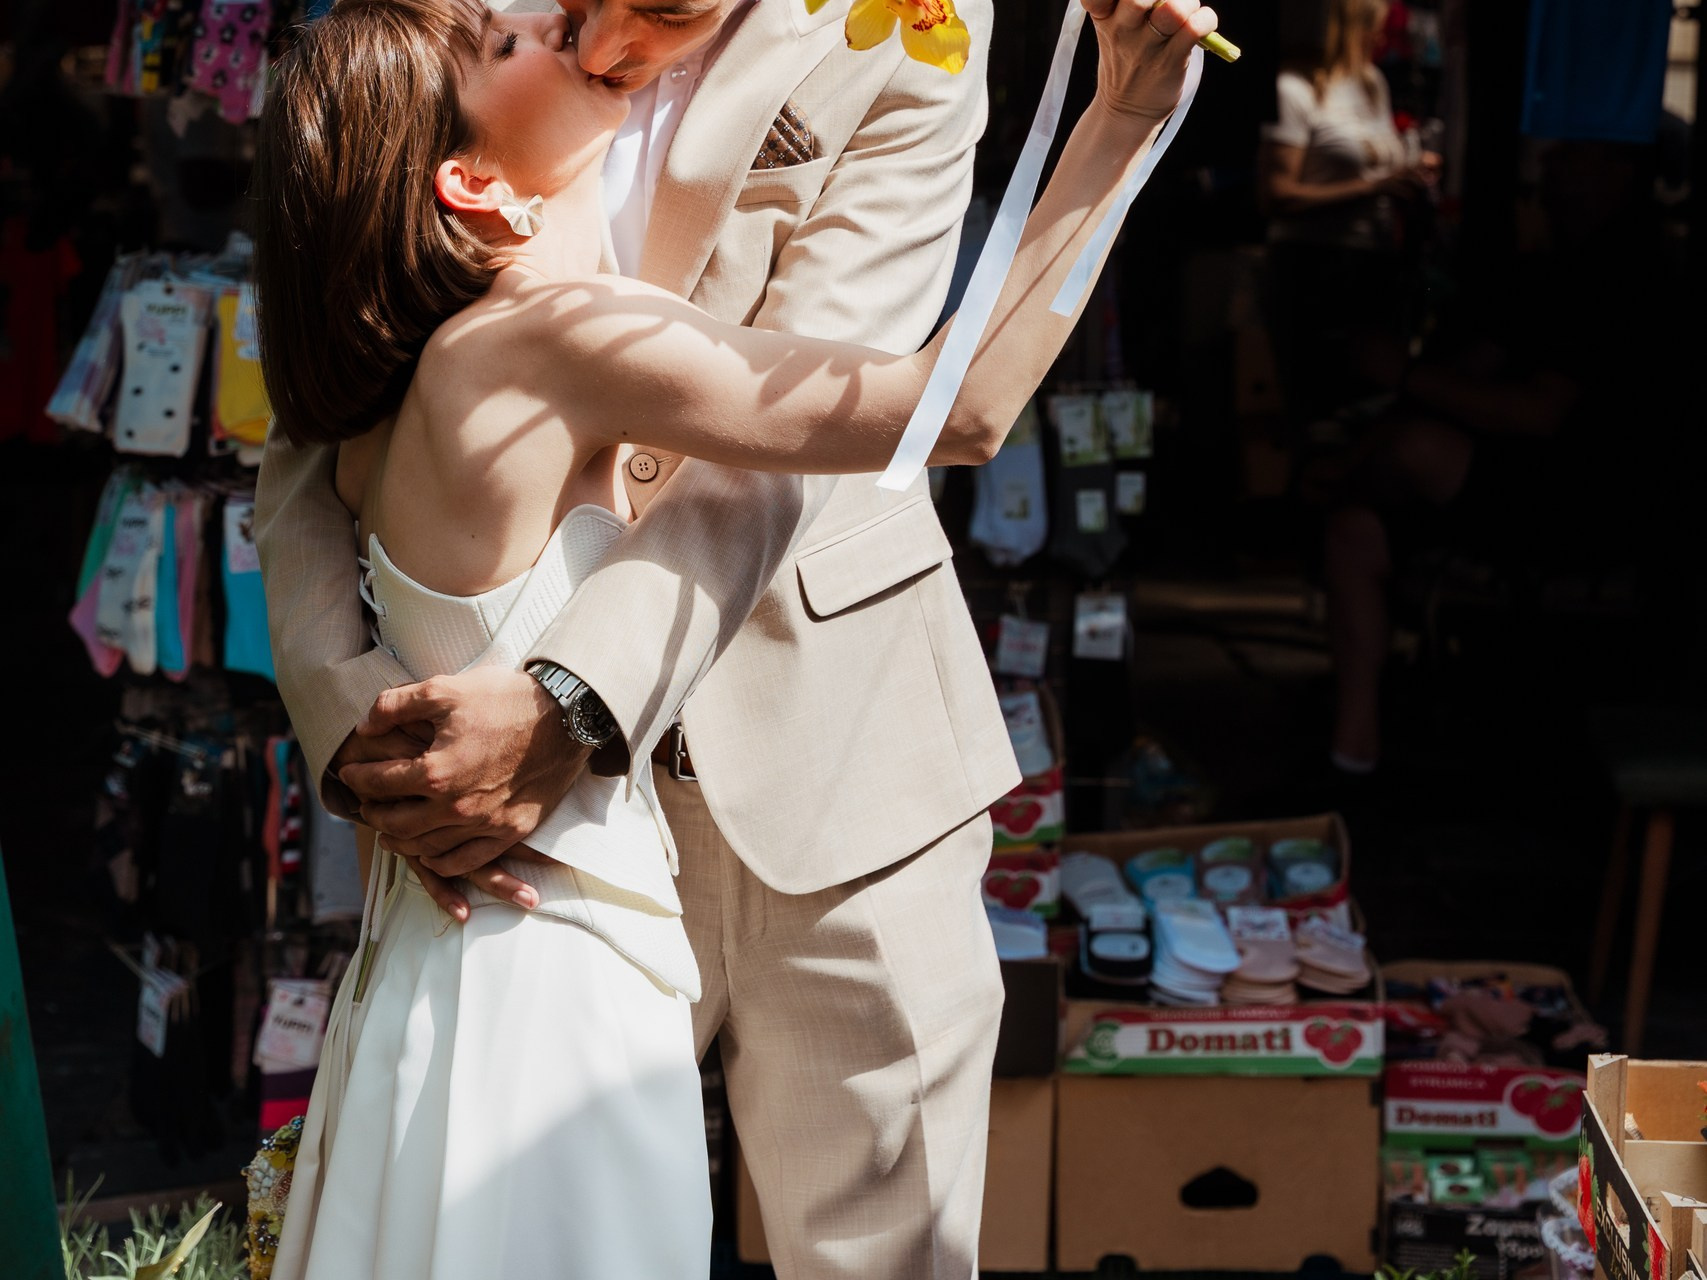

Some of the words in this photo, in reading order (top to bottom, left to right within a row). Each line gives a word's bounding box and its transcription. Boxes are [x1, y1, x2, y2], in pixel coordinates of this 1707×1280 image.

[1148, 1027, 1291, 1052] Domati
[1397, 1106, 1497, 1126] Domati
[1596, 1196, 1641, 1280] EXCLUSIV
